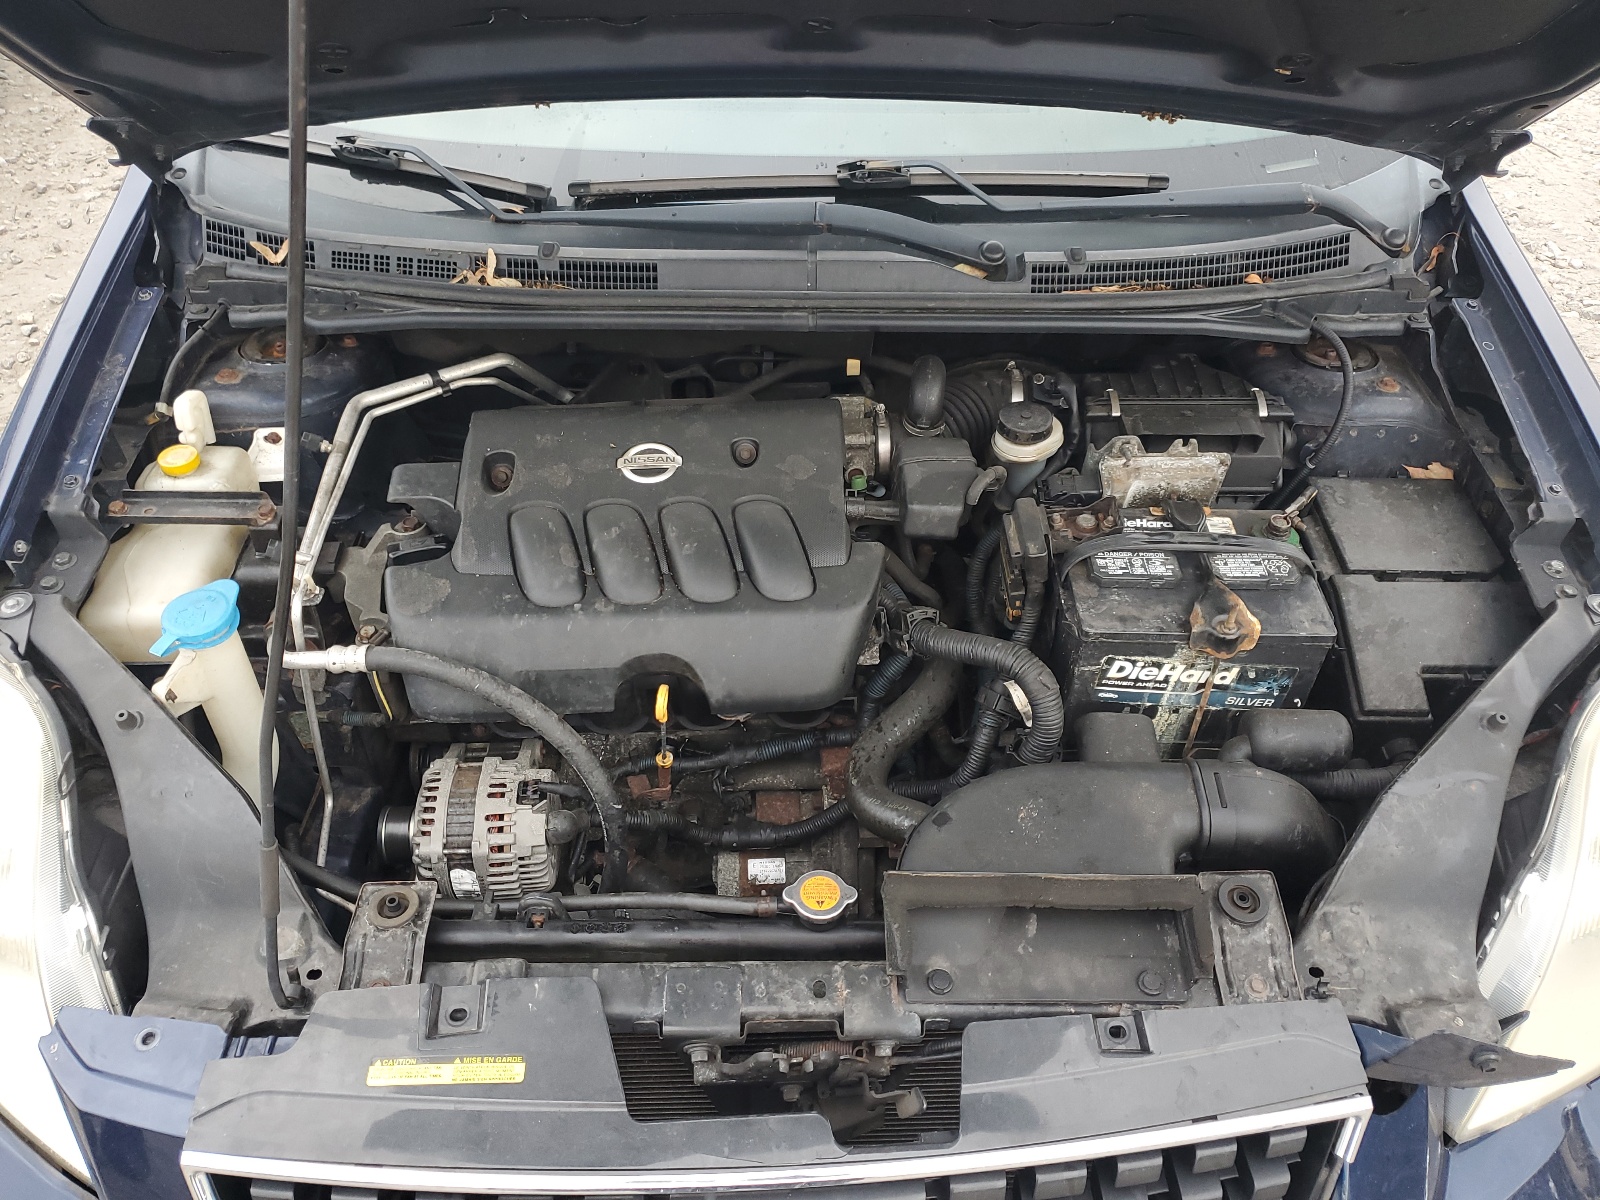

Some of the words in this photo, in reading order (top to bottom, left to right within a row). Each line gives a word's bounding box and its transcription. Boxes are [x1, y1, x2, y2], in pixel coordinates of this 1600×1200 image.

[623, 456, 676, 465] NISSAN
[1106, 660, 1240, 685] DieHard
[1102, 679, 1134, 687] POWER
[1225, 696, 1275, 708] SILVER
[382, 1058, 417, 1066] CAUTION
[483, 1056, 495, 1064] EN
